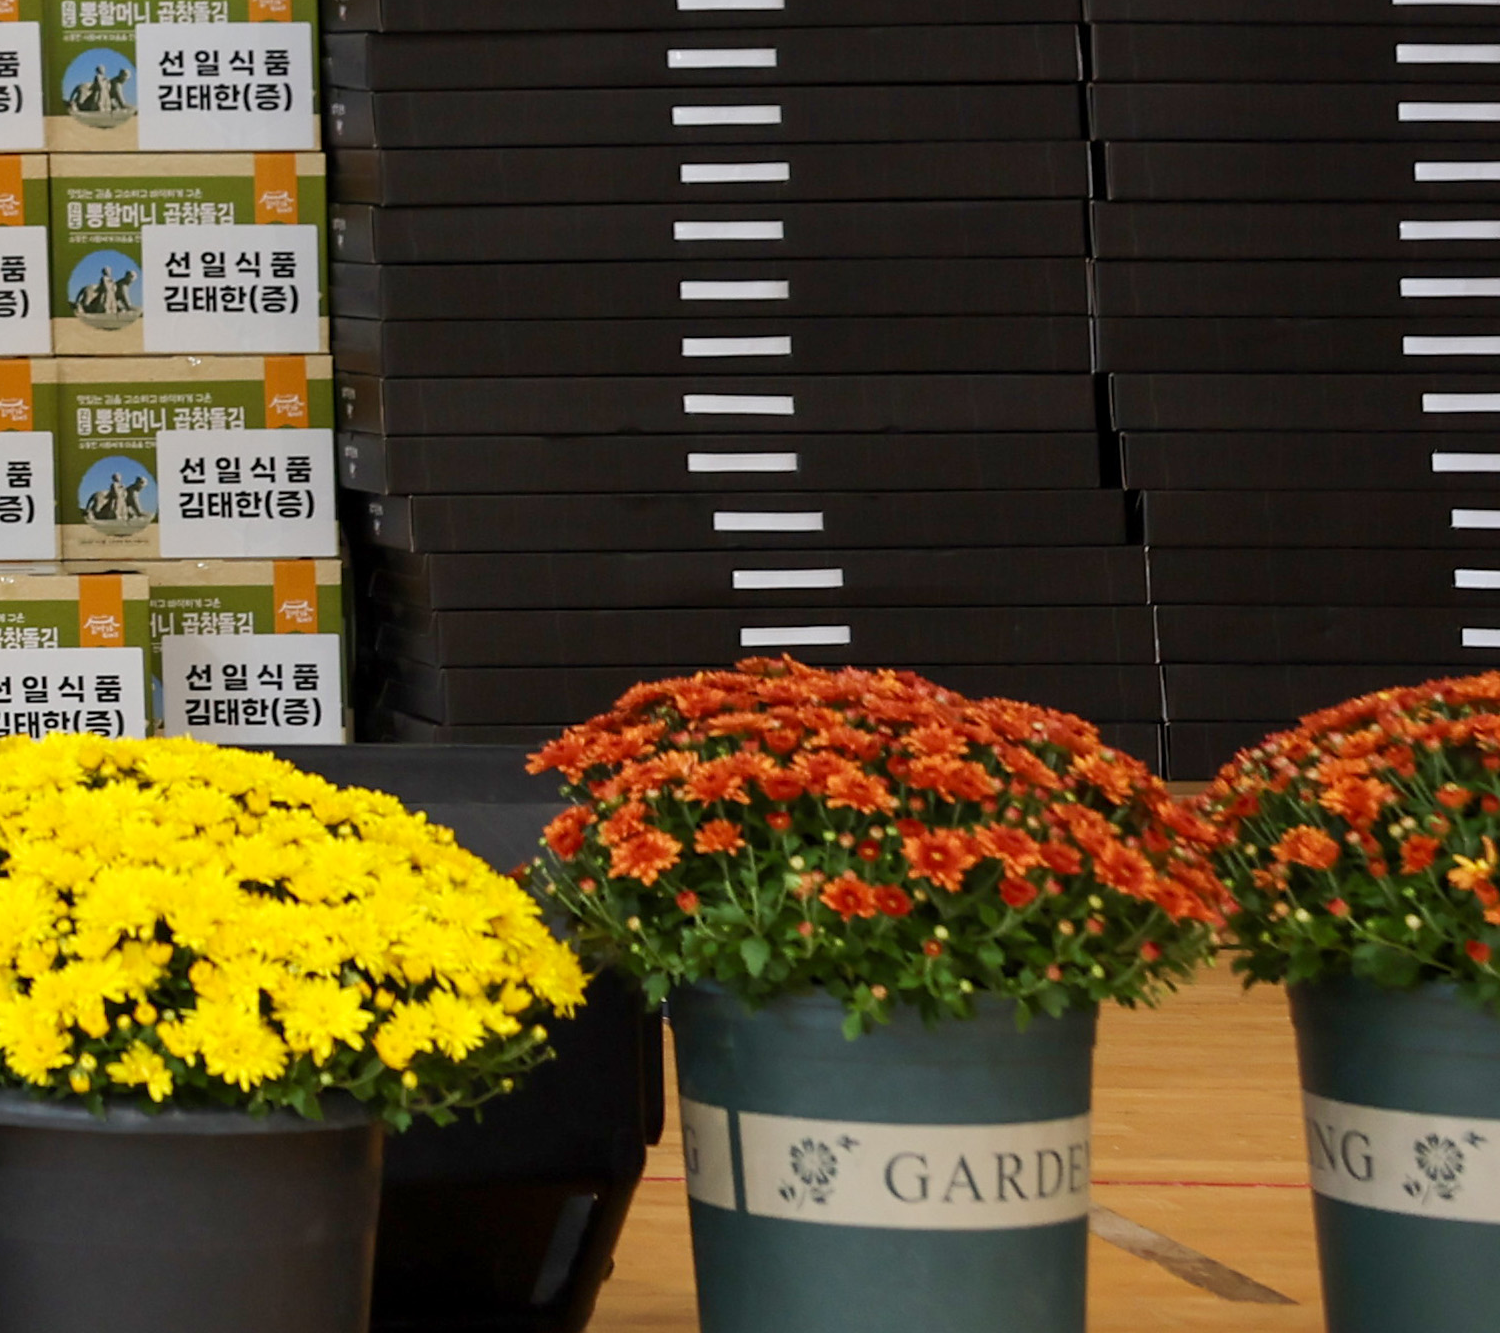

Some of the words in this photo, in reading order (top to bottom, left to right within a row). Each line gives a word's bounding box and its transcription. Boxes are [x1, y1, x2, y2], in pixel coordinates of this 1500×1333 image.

[159, 83, 292, 111] 김태한(증)
[164, 285, 298, 313] 김태한(증)
[180, 490, 314, 519] 김태한(증)
[185, 698, 321, 726] 김태한(증)
[883, 1145, 1089, 1204] GARDE
